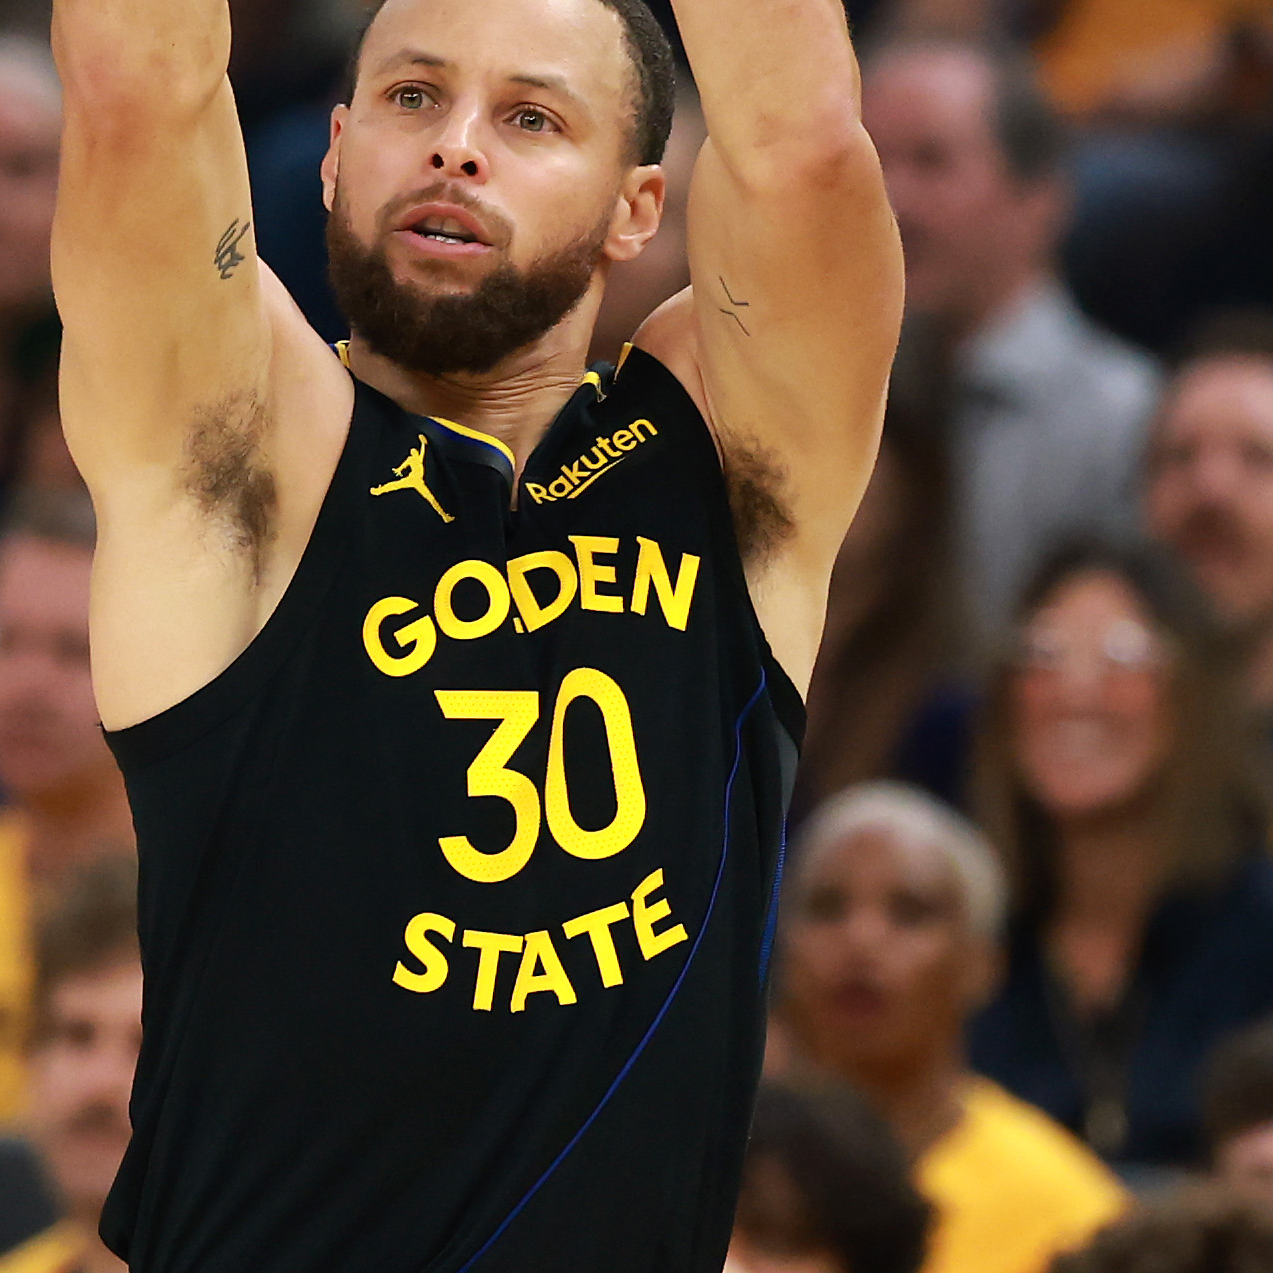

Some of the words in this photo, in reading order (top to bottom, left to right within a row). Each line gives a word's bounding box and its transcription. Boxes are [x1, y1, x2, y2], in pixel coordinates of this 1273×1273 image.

[524, 418, 659, 505] Rakuten
[362, 534, 701, 678] GODEN
[433, 666, 647, 884] 30
[392, 866, 690, 1015] STATE
